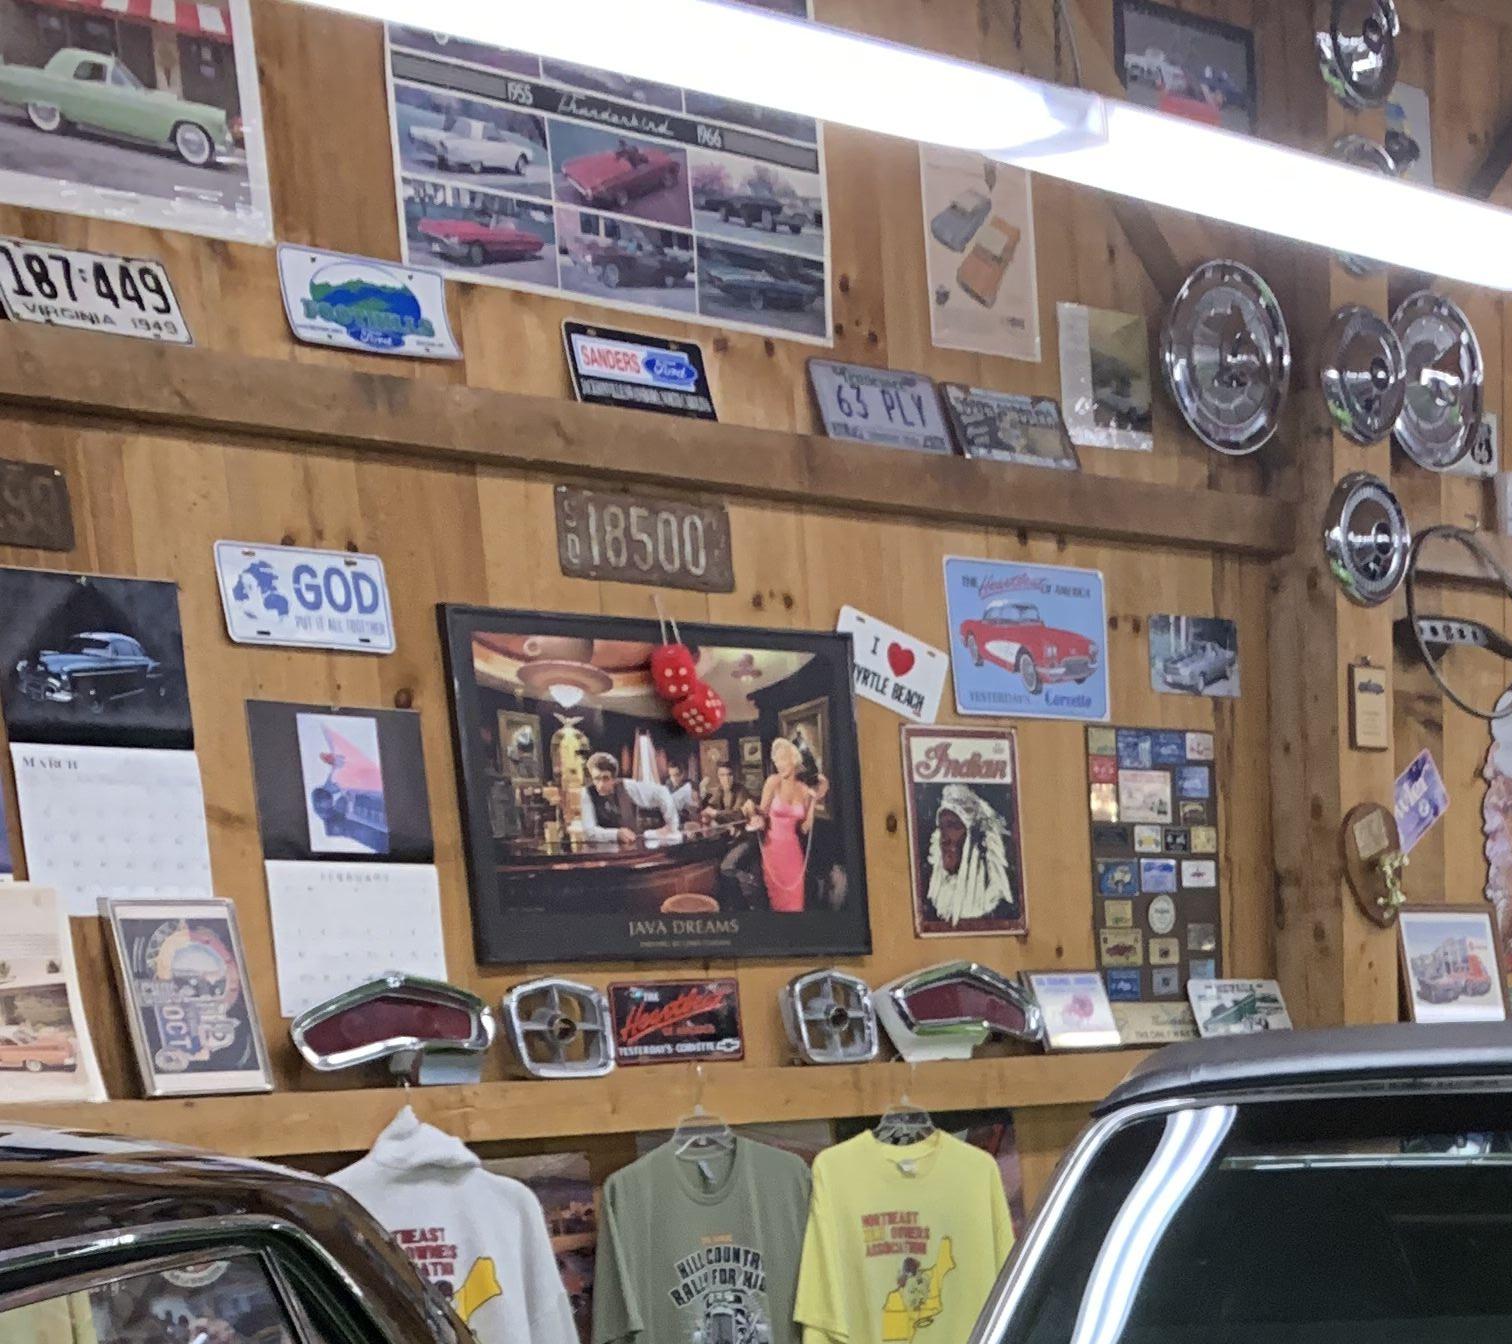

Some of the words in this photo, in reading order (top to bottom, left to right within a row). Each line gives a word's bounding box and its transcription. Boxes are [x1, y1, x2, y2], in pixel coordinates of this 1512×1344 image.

[507, 80, 533, 105] 1955
[697, 125, 723, 148] 1966
[23, 302, 117, 327] VIRGINIA
[131, 318, 178, 336] 1949
[580, 345, 641, 374] SANDERS
[837, 385, 869, 419] 63
[880, 388, 926, 427] PLY
[588, 502, 707, 576] 18500
[292, 564, 379, 615] GOD
[870, 636, 879, 655] I
[853, 662, 890, 696] YRTLE
[891, 682, 925, 712] BEACH
[915, 742, 1007, 780] Indian
[629, 919, 667, 937] JAVA
[672, 918, 739, 935] DREAMS
[676, 1253, 705, 1279] HILL
[670, 1271, 708, 1306] RALLY
[712, 1268, 736, 1286] FOR
